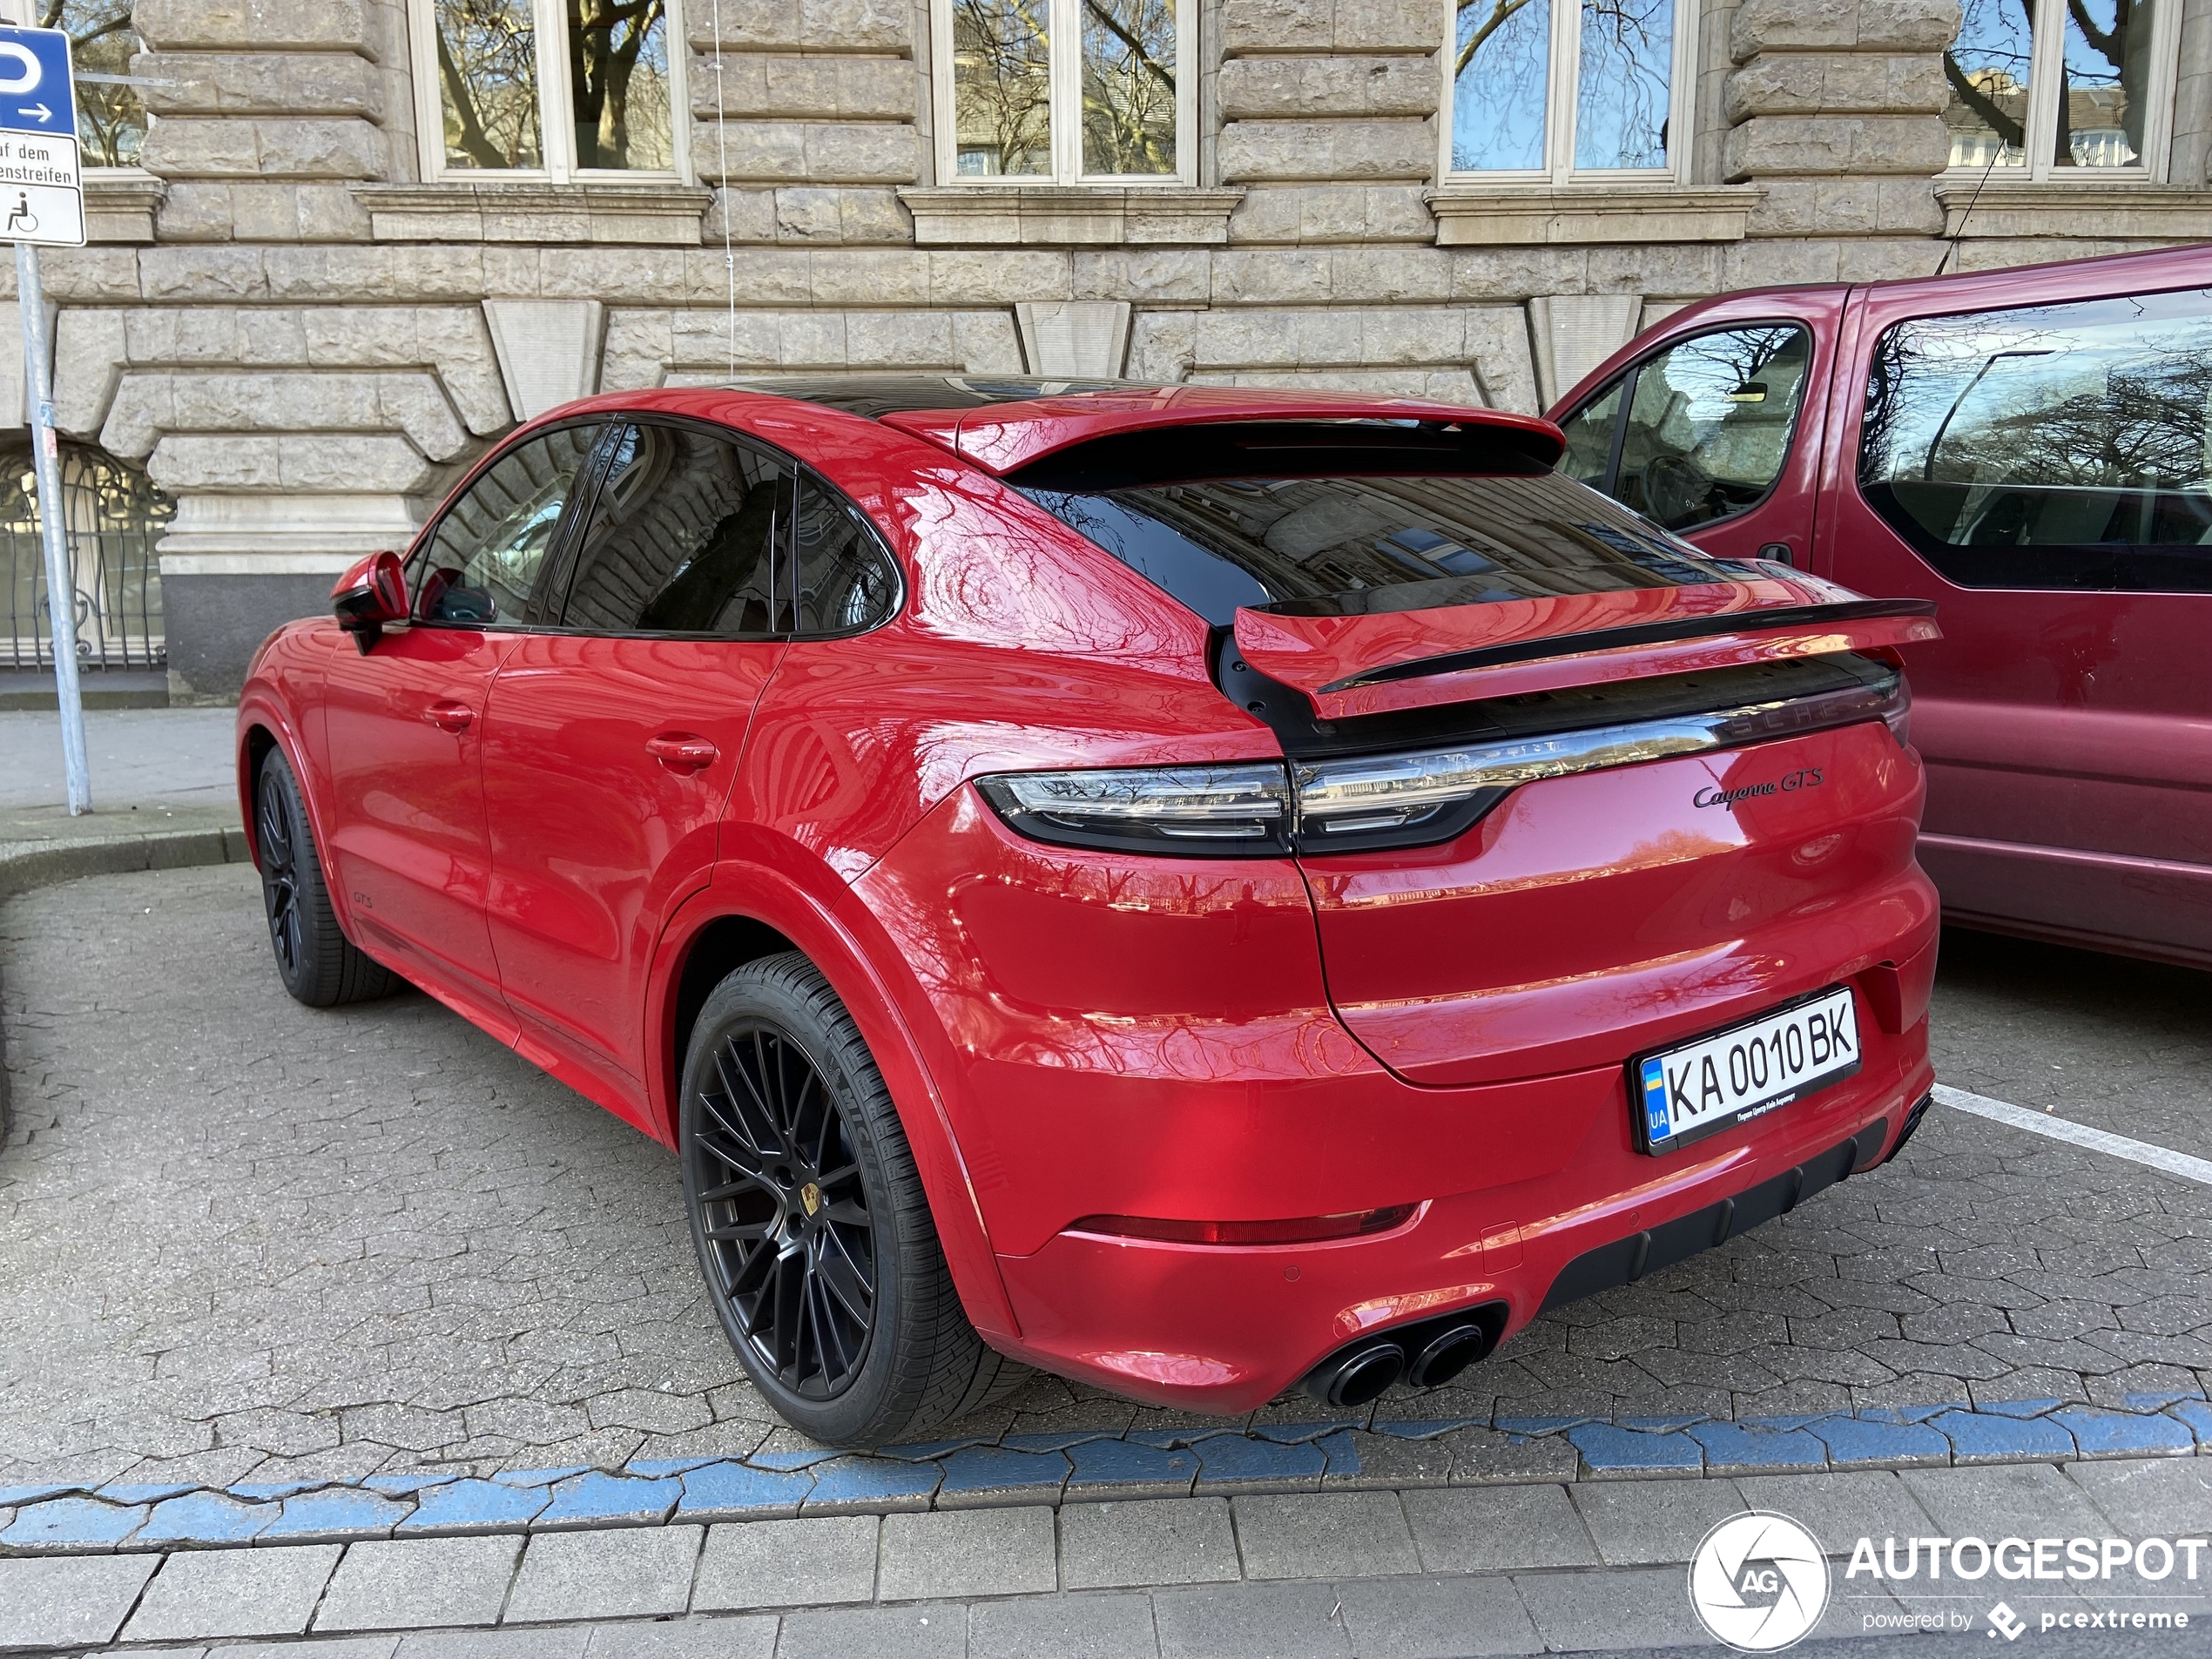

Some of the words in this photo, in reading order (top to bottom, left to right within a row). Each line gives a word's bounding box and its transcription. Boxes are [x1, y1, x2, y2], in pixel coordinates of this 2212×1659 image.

[18, 144, 49, 161] dem
[1693, 781, 1777, 811] Cayenne
[1782, 766, 1824, 791] GTS
[354, 892, 373, 908] GTS
[1668, 1055, 1723, 1122] KA
[1729, 1022, 1804, 1096] 0010
[1808, 1002, 1852, 1067] BK
[1649, 1109, 1668, 1130] UA
[840, 1088, 891, 1244] MICHELIN
